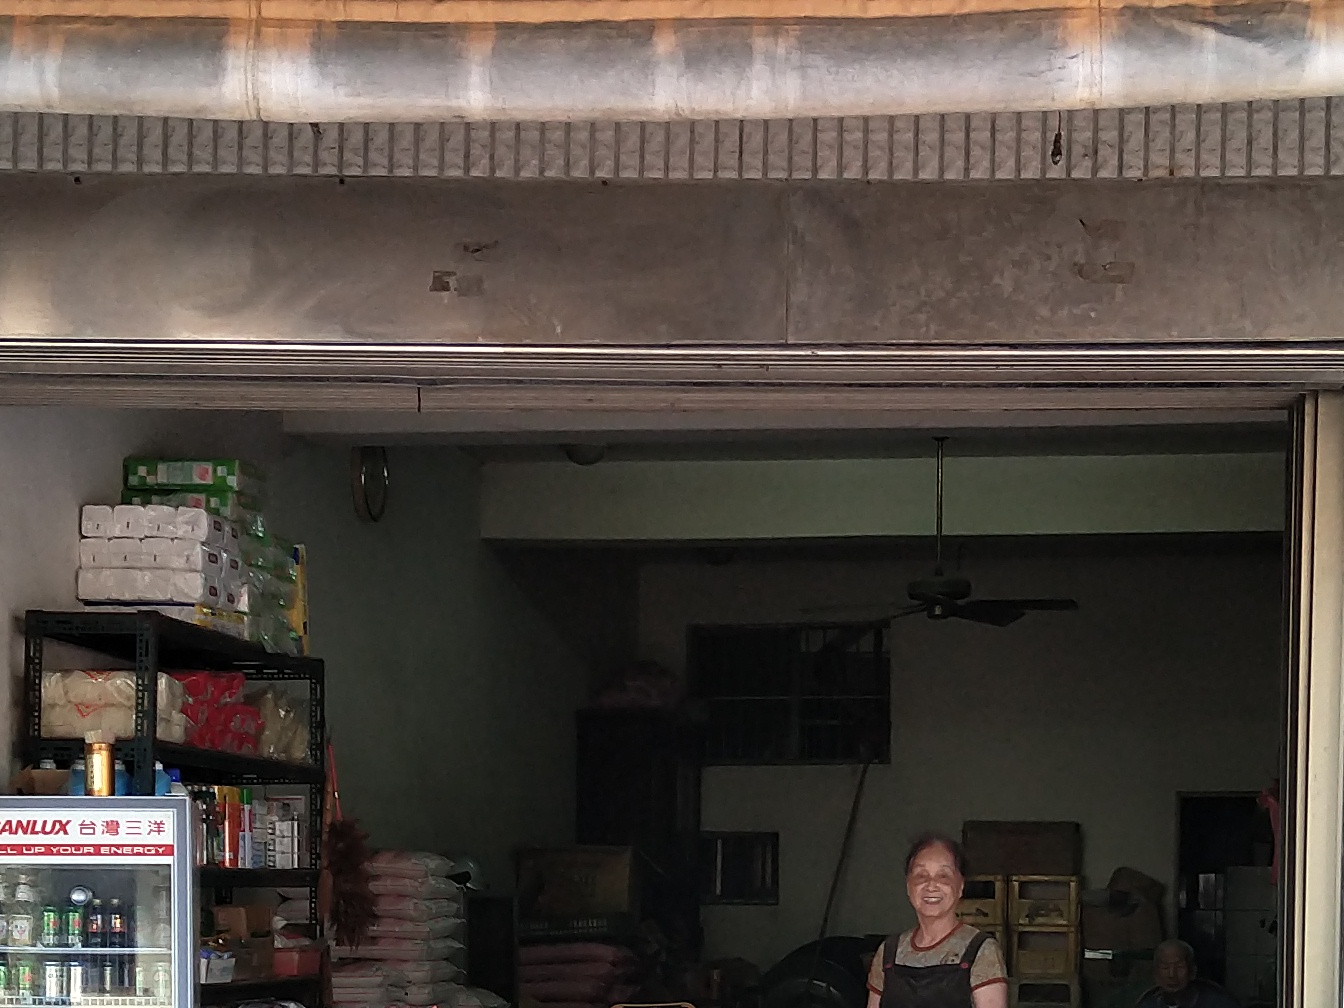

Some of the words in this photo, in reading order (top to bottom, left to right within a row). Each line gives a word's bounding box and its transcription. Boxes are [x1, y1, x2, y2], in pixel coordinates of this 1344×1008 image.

[77, 819, 166, 836] 台灣三洋
[23, 846, 45, 854] UP
[50, 846, 94, 854] YOUR
[100, 846, 166, 854] ENERGY
